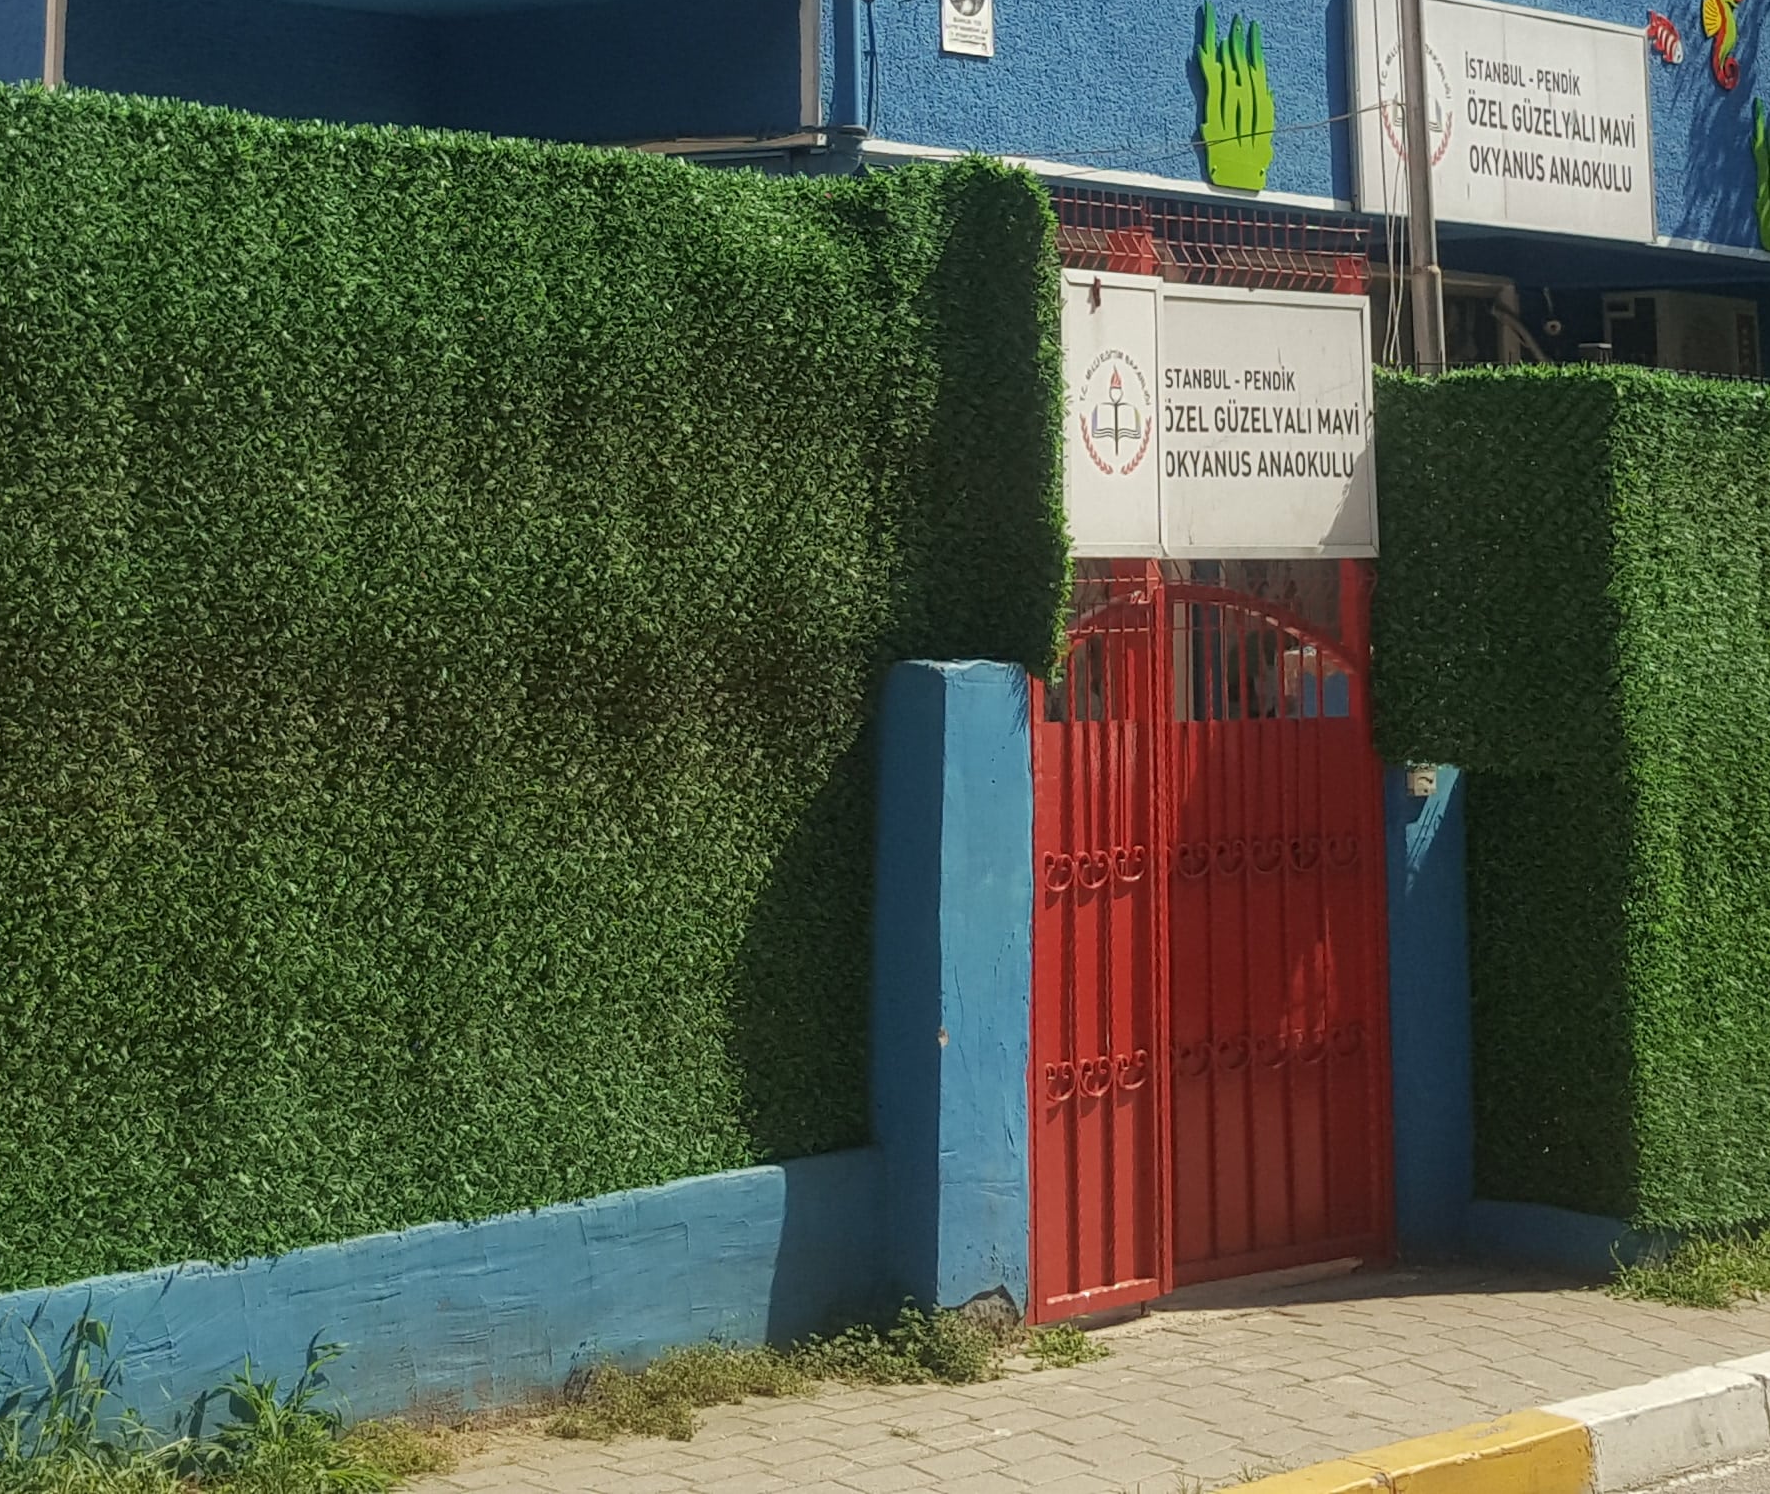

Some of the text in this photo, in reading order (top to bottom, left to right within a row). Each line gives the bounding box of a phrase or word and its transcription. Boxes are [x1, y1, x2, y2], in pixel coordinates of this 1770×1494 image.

[1465, 51, 1526, 88] İSTANBUL
[1537, 68, 1581, 96] PENDİK
[1467, 89, 1636, 148] ÖZEL GÜZELYALI MAVİ
[1469, 144, 1632, 193] OKYANUS ANAOKULU
[1165, 368, 1231, 389] STANBUL
[1244, 366, 1295, 391] PENDİK
[1214, 399, 1312, 434] GÜZELYALI
[1318, 402, 1360, 435] MAVİ
[1166, 450, 1355, 478] OKYANUS ANAOKULU
